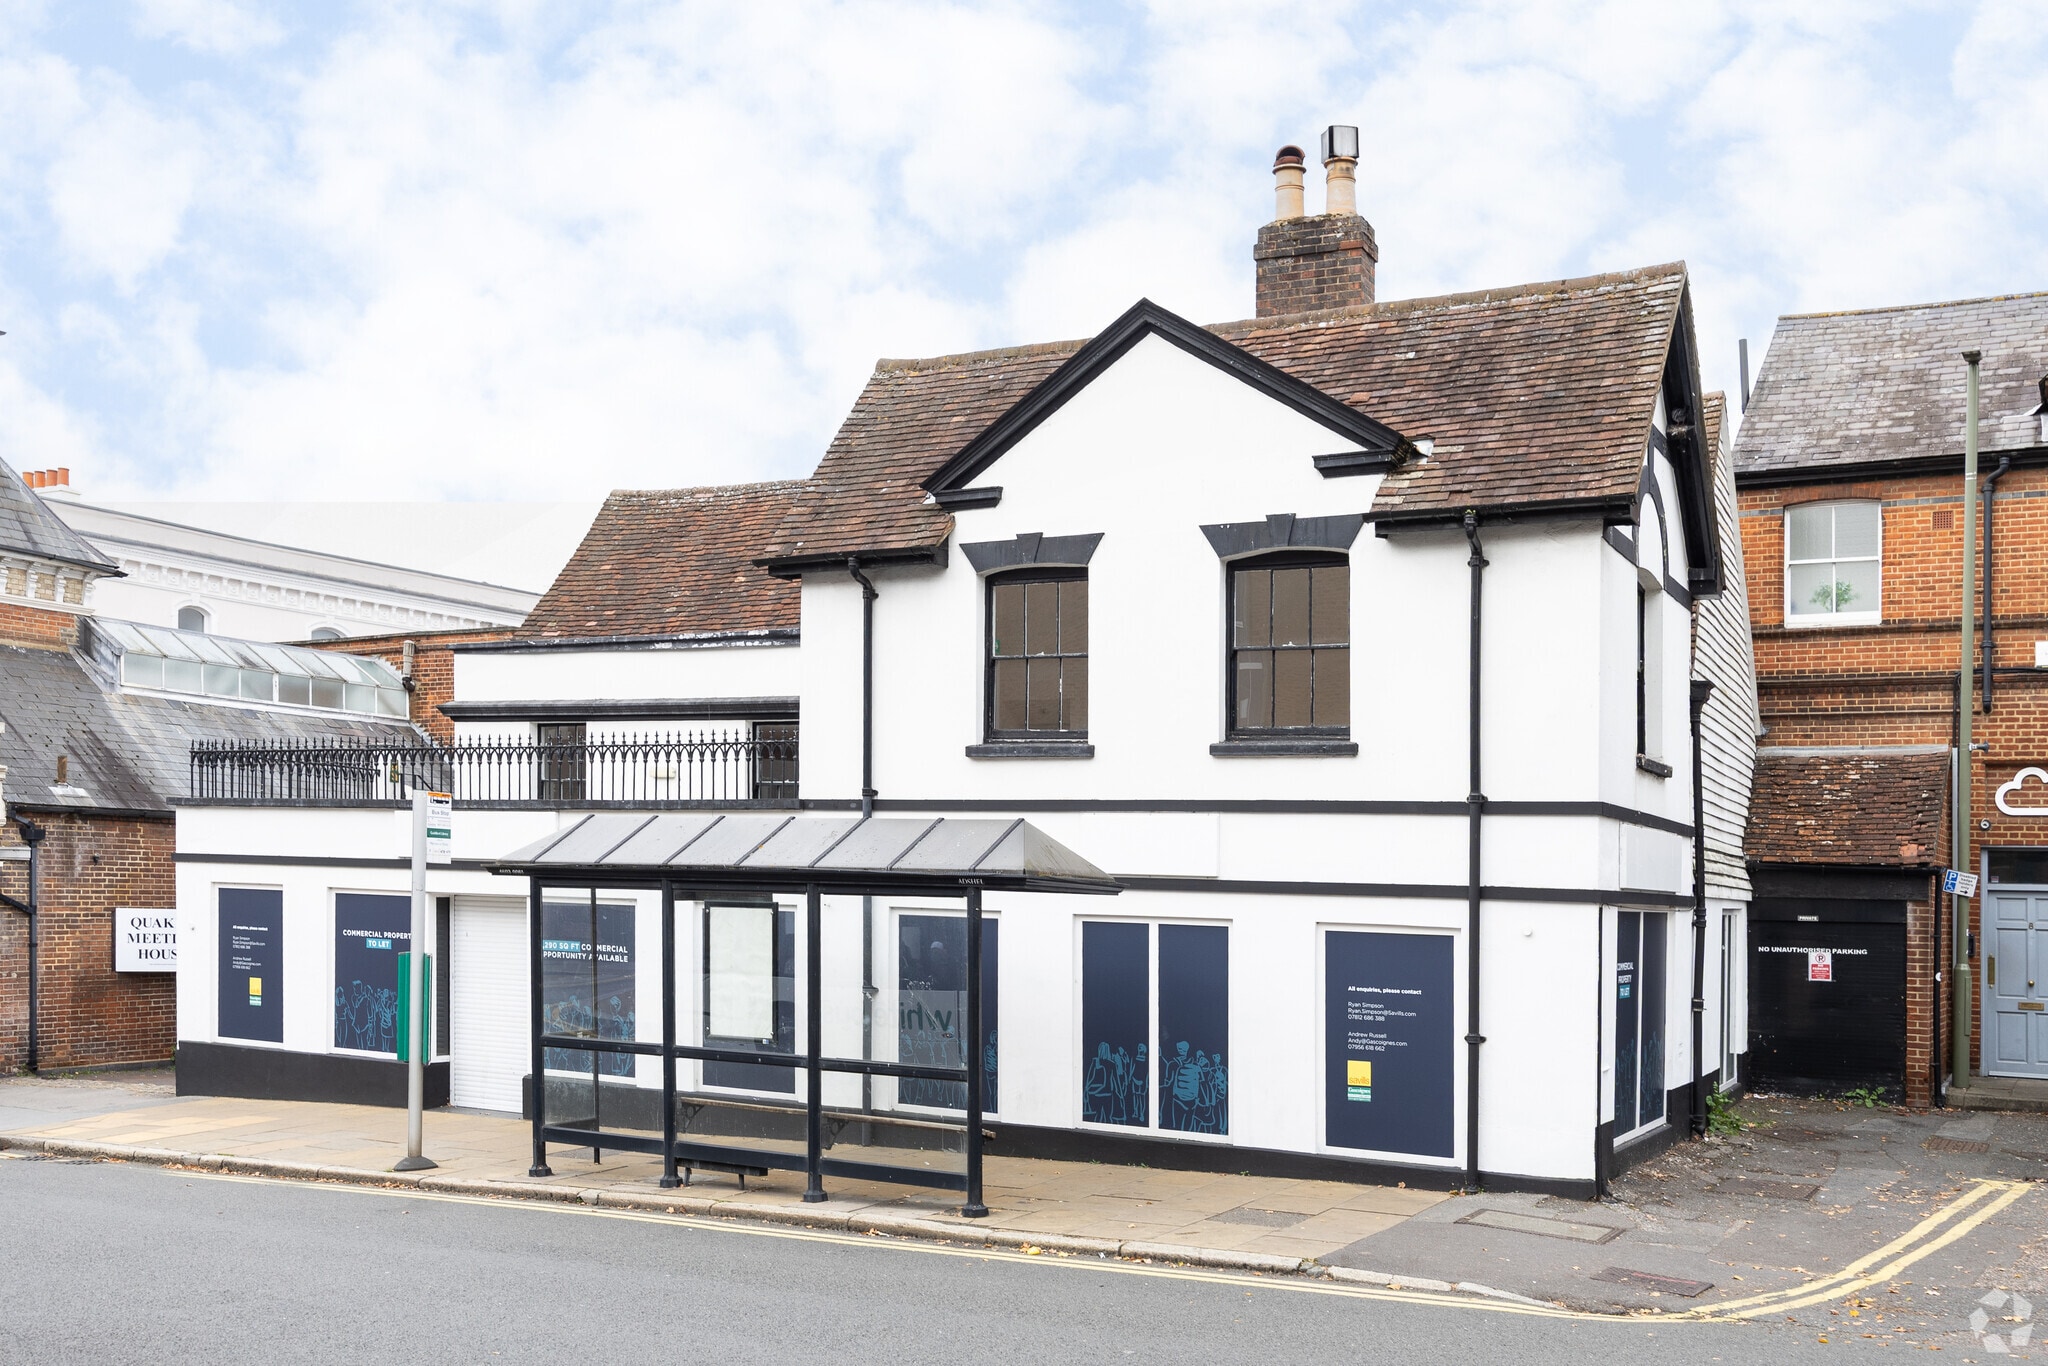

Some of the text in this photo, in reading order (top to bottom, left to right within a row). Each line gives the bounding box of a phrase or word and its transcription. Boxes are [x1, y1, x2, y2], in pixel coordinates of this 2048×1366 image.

[130, 917, 174, 930] QUAK
[128, 933, 176, 943] MEETI
[342, 929, 382, 938] COMMERCIAL
[581, 944, 628, 953] COMERCIAL
[138, 949, 176, 960] HOUS
[589, 954, 628, 962] AAILABLE
[1348, 1008, 1416, 1016] Ryan.Simpson@Savills.com
[1348, 1038, 1407, 1046] Andy@Gascoignes.com
[1349, 1076, 1369, 1085] savills
